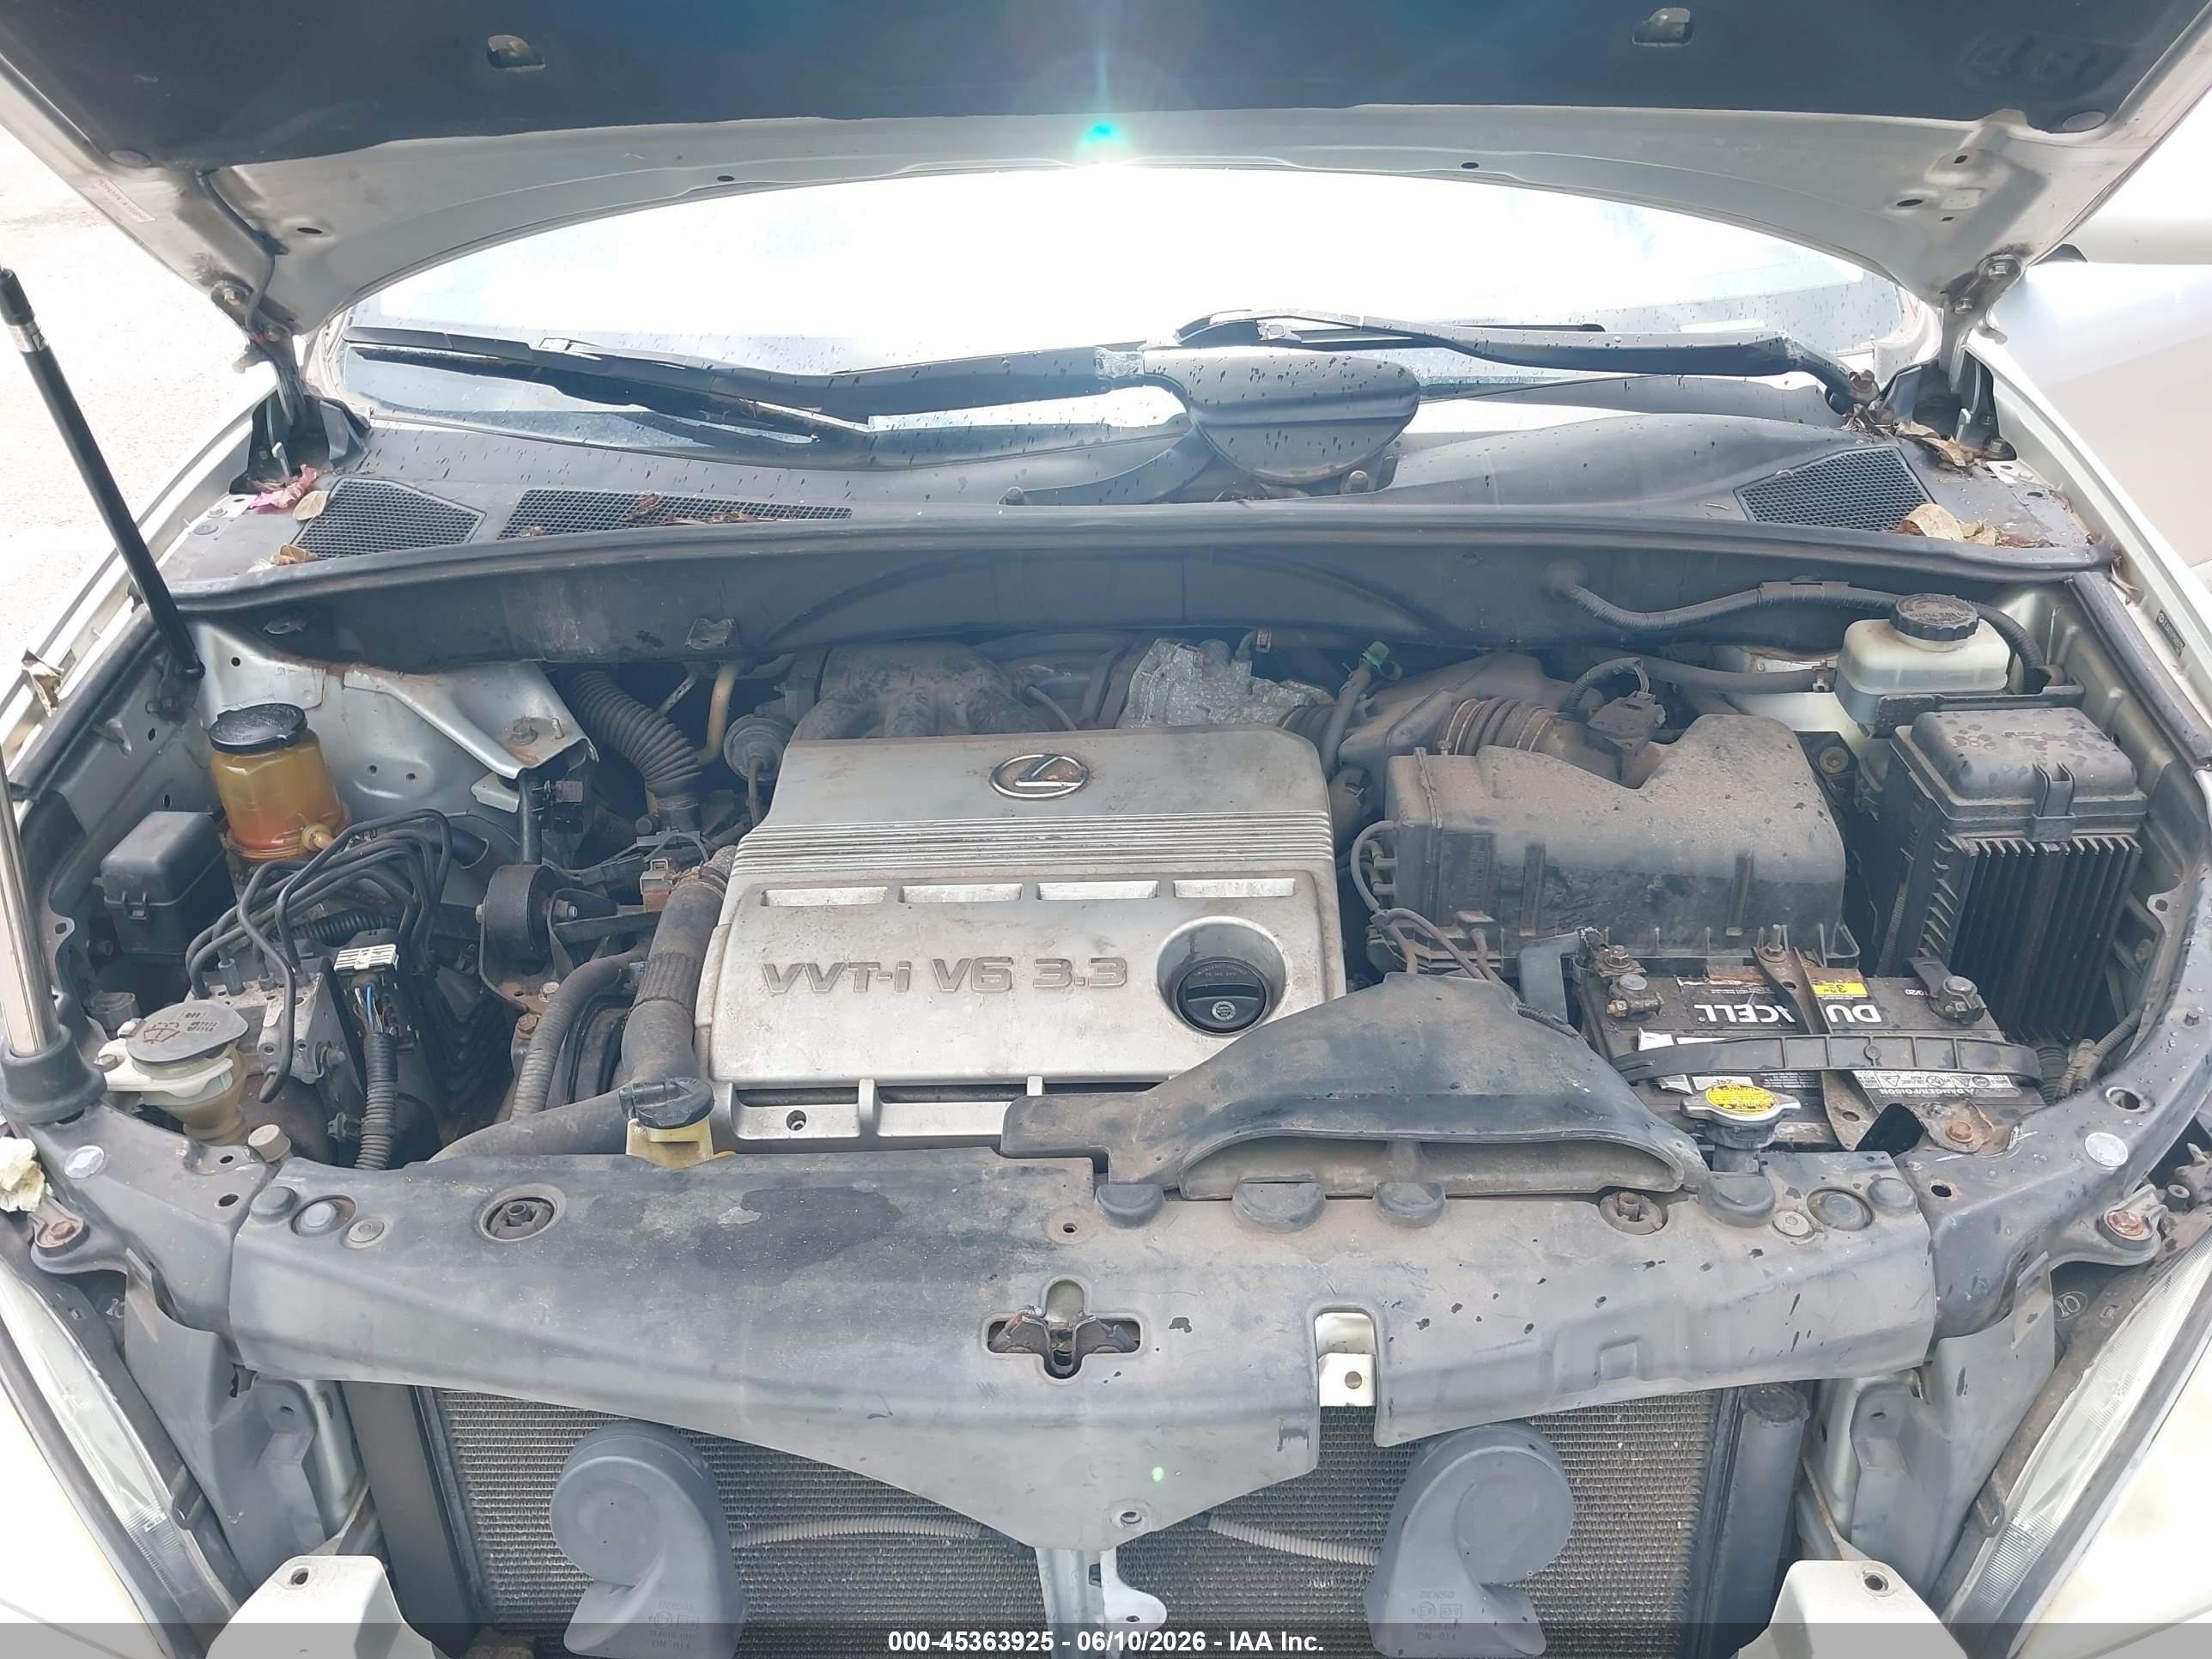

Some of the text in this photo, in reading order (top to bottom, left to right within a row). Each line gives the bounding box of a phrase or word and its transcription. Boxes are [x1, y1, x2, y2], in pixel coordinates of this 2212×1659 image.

[762, 956, 1127, 994] VVT-i V6 3.3
